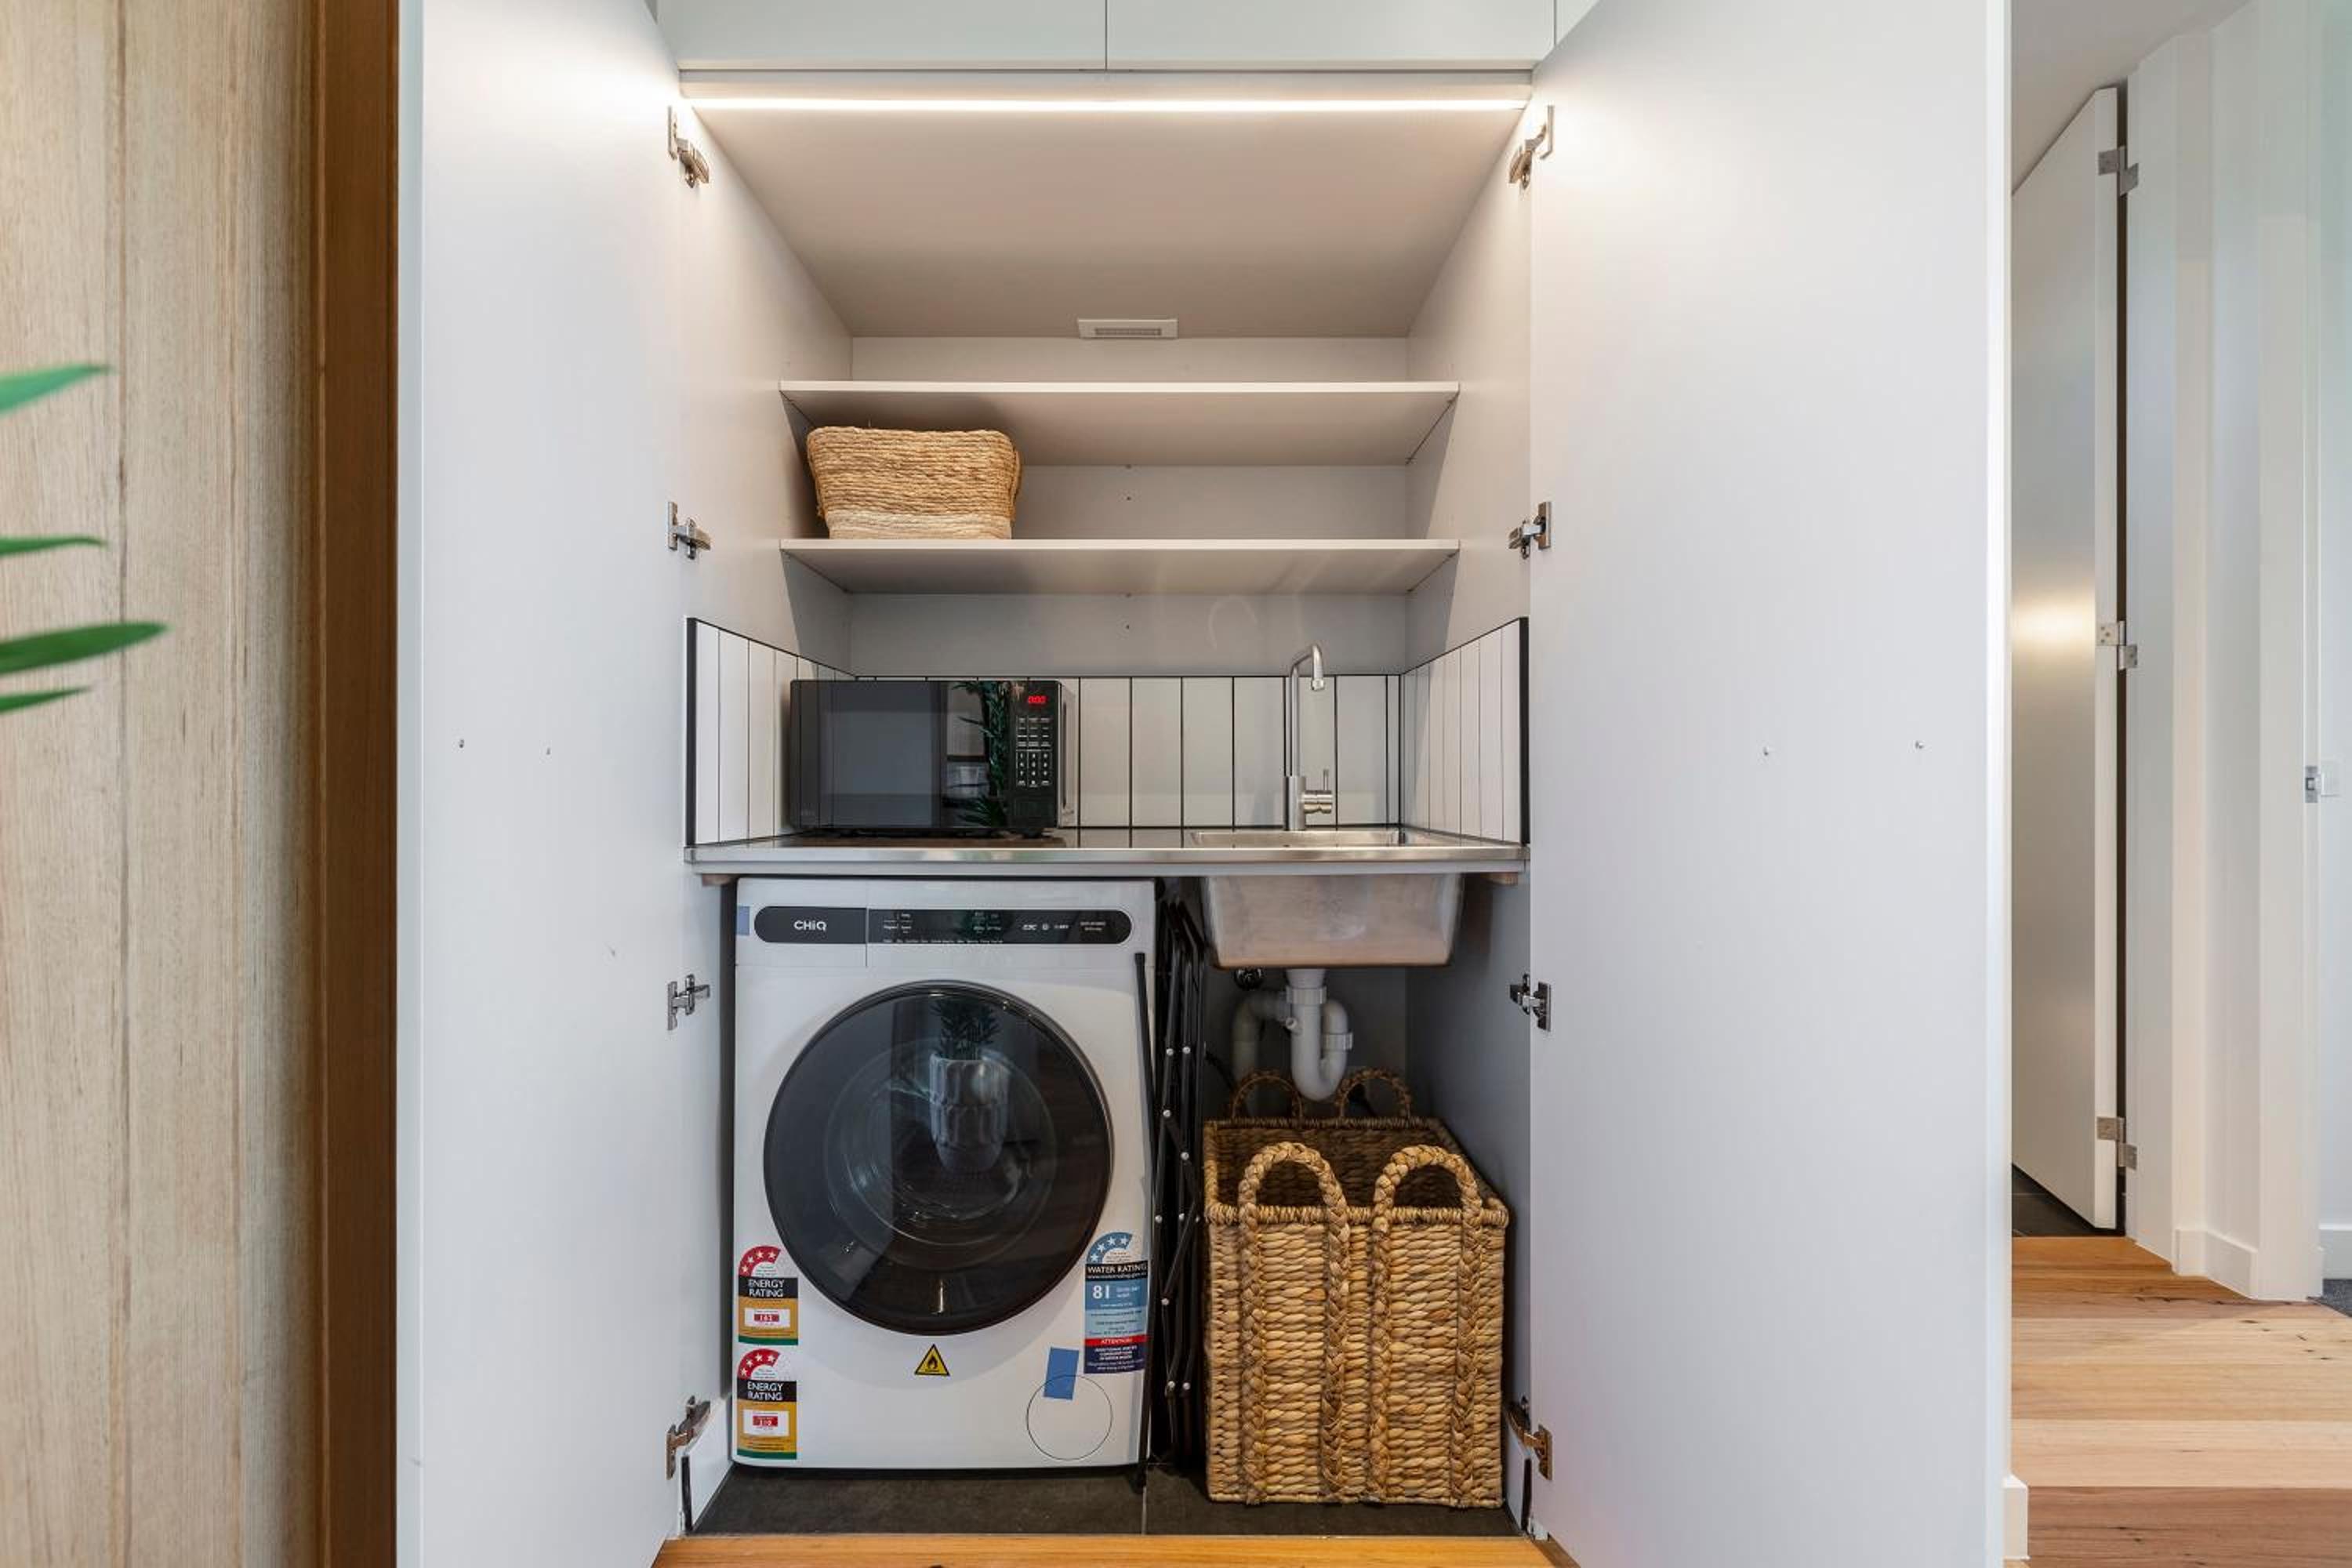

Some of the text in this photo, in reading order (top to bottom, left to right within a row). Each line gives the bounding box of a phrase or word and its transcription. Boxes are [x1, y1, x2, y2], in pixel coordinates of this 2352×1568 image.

[793, 920, 827, 931] CHiQ
[1117, 1262, 1147, 1272] RATING
[748, 1279, 785, 1288] ENERGY
[749, 1288, 784, 1298] RATING
[747, 1381, 783, 1392] ENERGY
[747, 1391, 783, 1401] RATING
